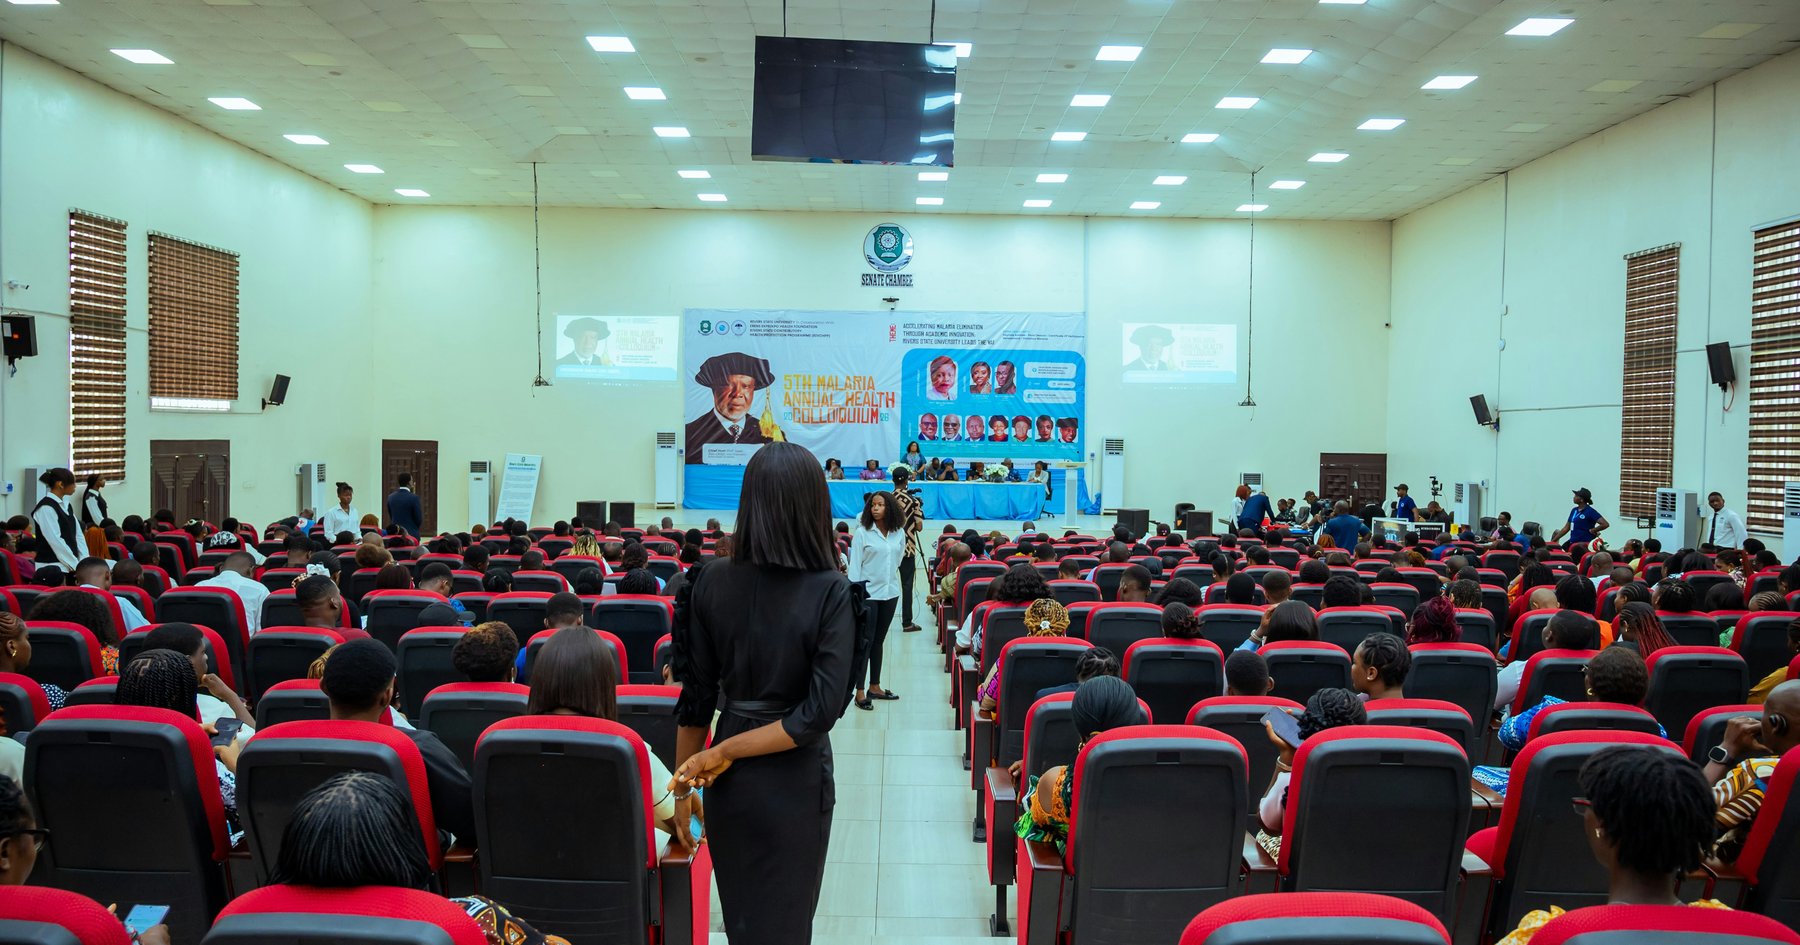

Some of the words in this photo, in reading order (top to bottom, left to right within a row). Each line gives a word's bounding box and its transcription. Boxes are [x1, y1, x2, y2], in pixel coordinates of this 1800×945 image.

[861, 273, 884, 286] SENATE
[783, 374, 812, 390] 5TH
[816, 374, 876, 391] MALARIA
[783, 391, 840, 408] ANNUAL
[845, 391, 895, 408] HEALTH
[792, 408, 879, 424] COLLOQUIUM
